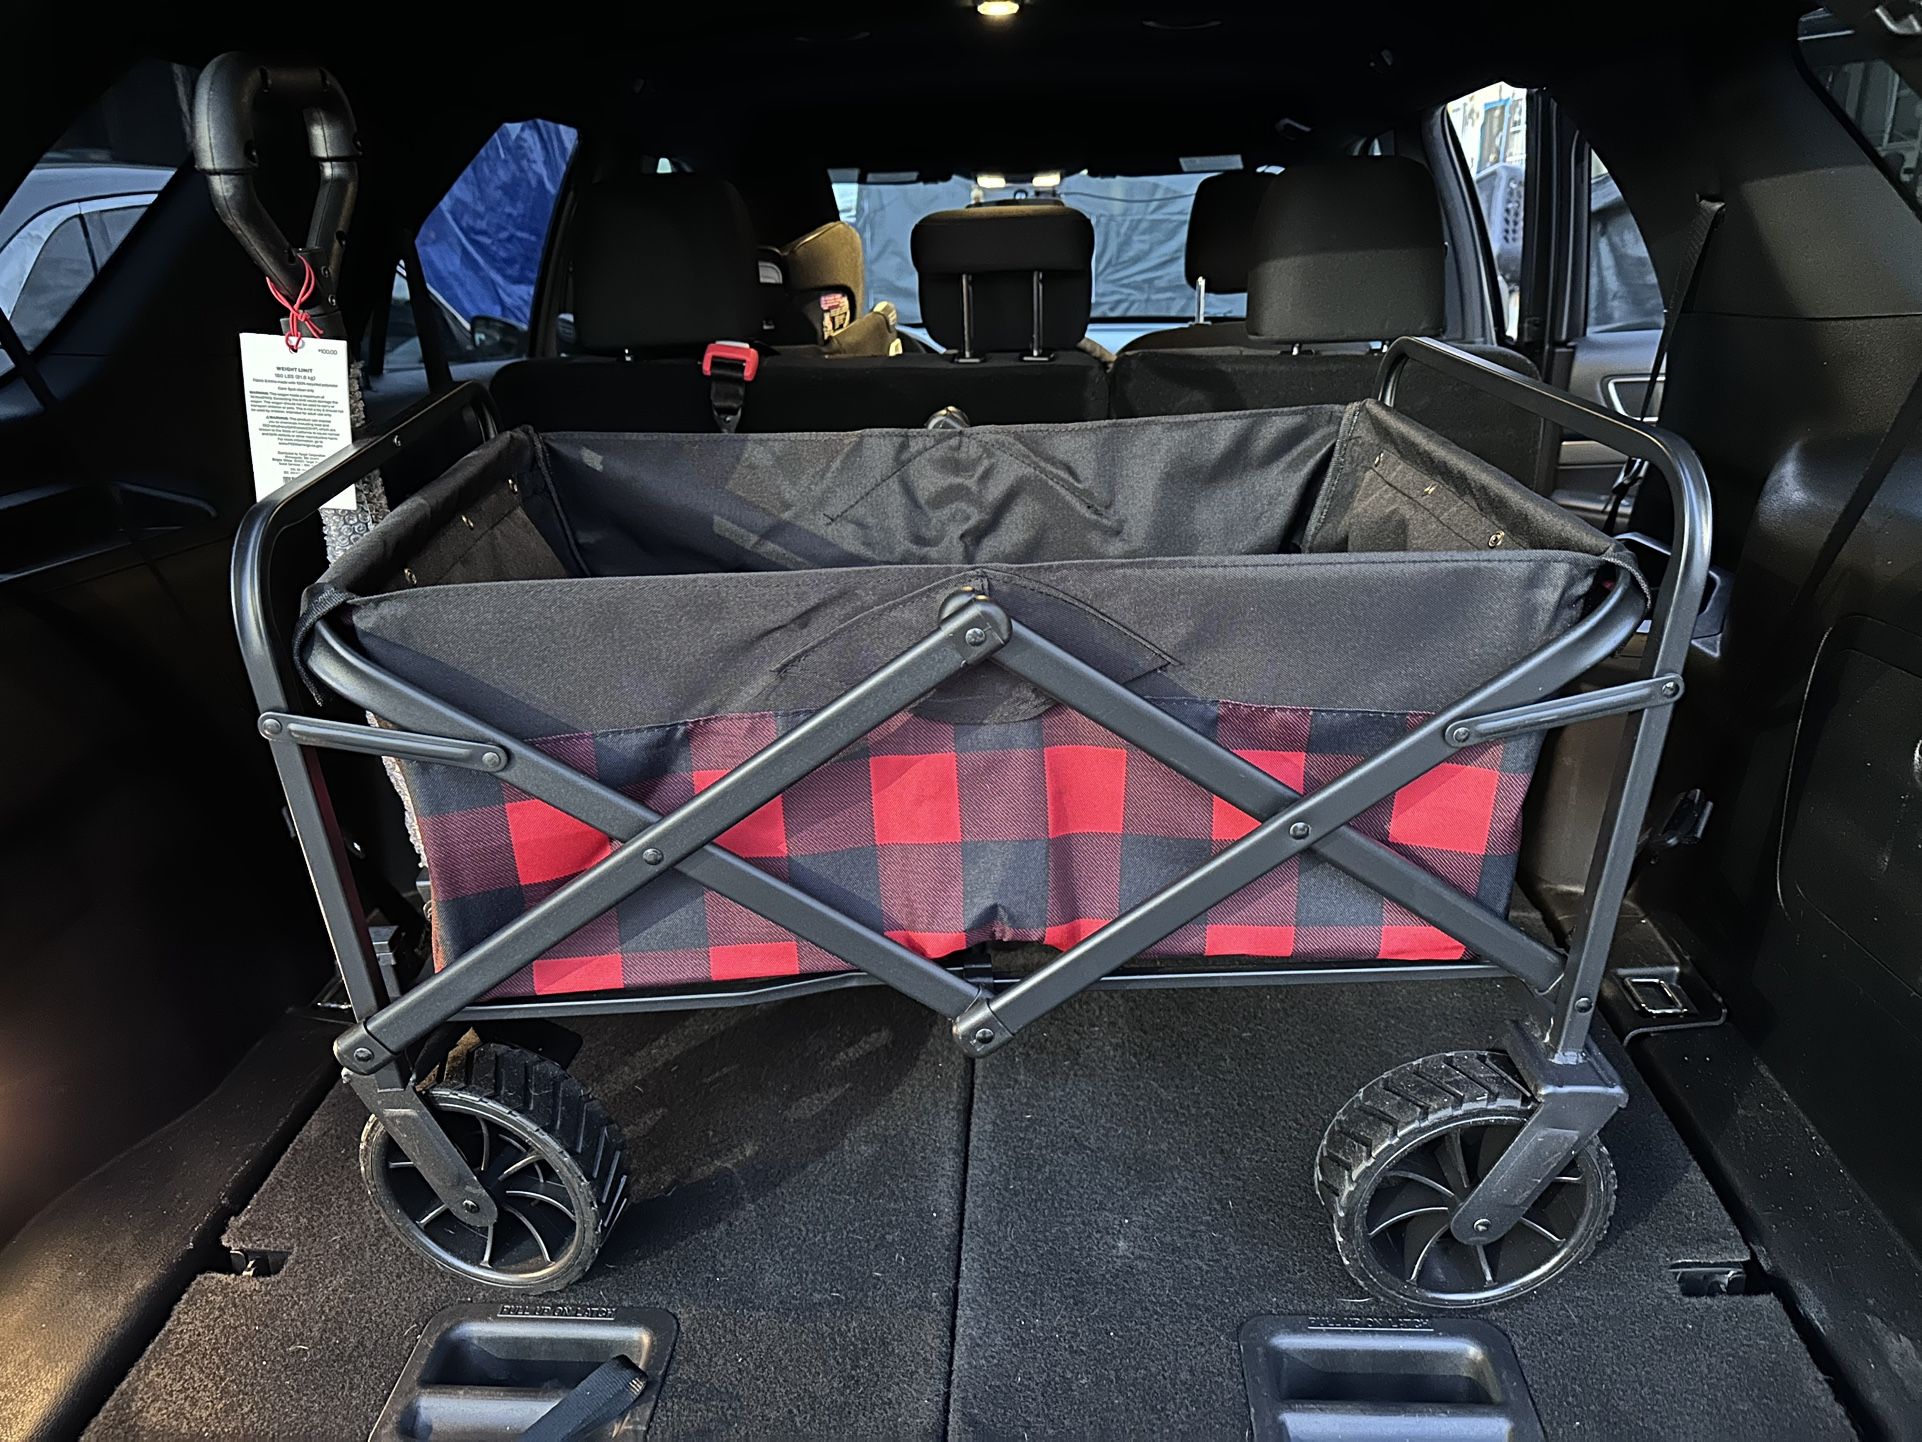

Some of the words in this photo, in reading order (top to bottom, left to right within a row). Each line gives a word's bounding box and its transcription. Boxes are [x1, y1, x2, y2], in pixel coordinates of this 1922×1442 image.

[501, 1304, 530, 1315] PULL
[534, 1305, 551, 1316] UP
[552, 1306, 572, 1317] ON
[576, 1307, 616, 1318] LATCH
